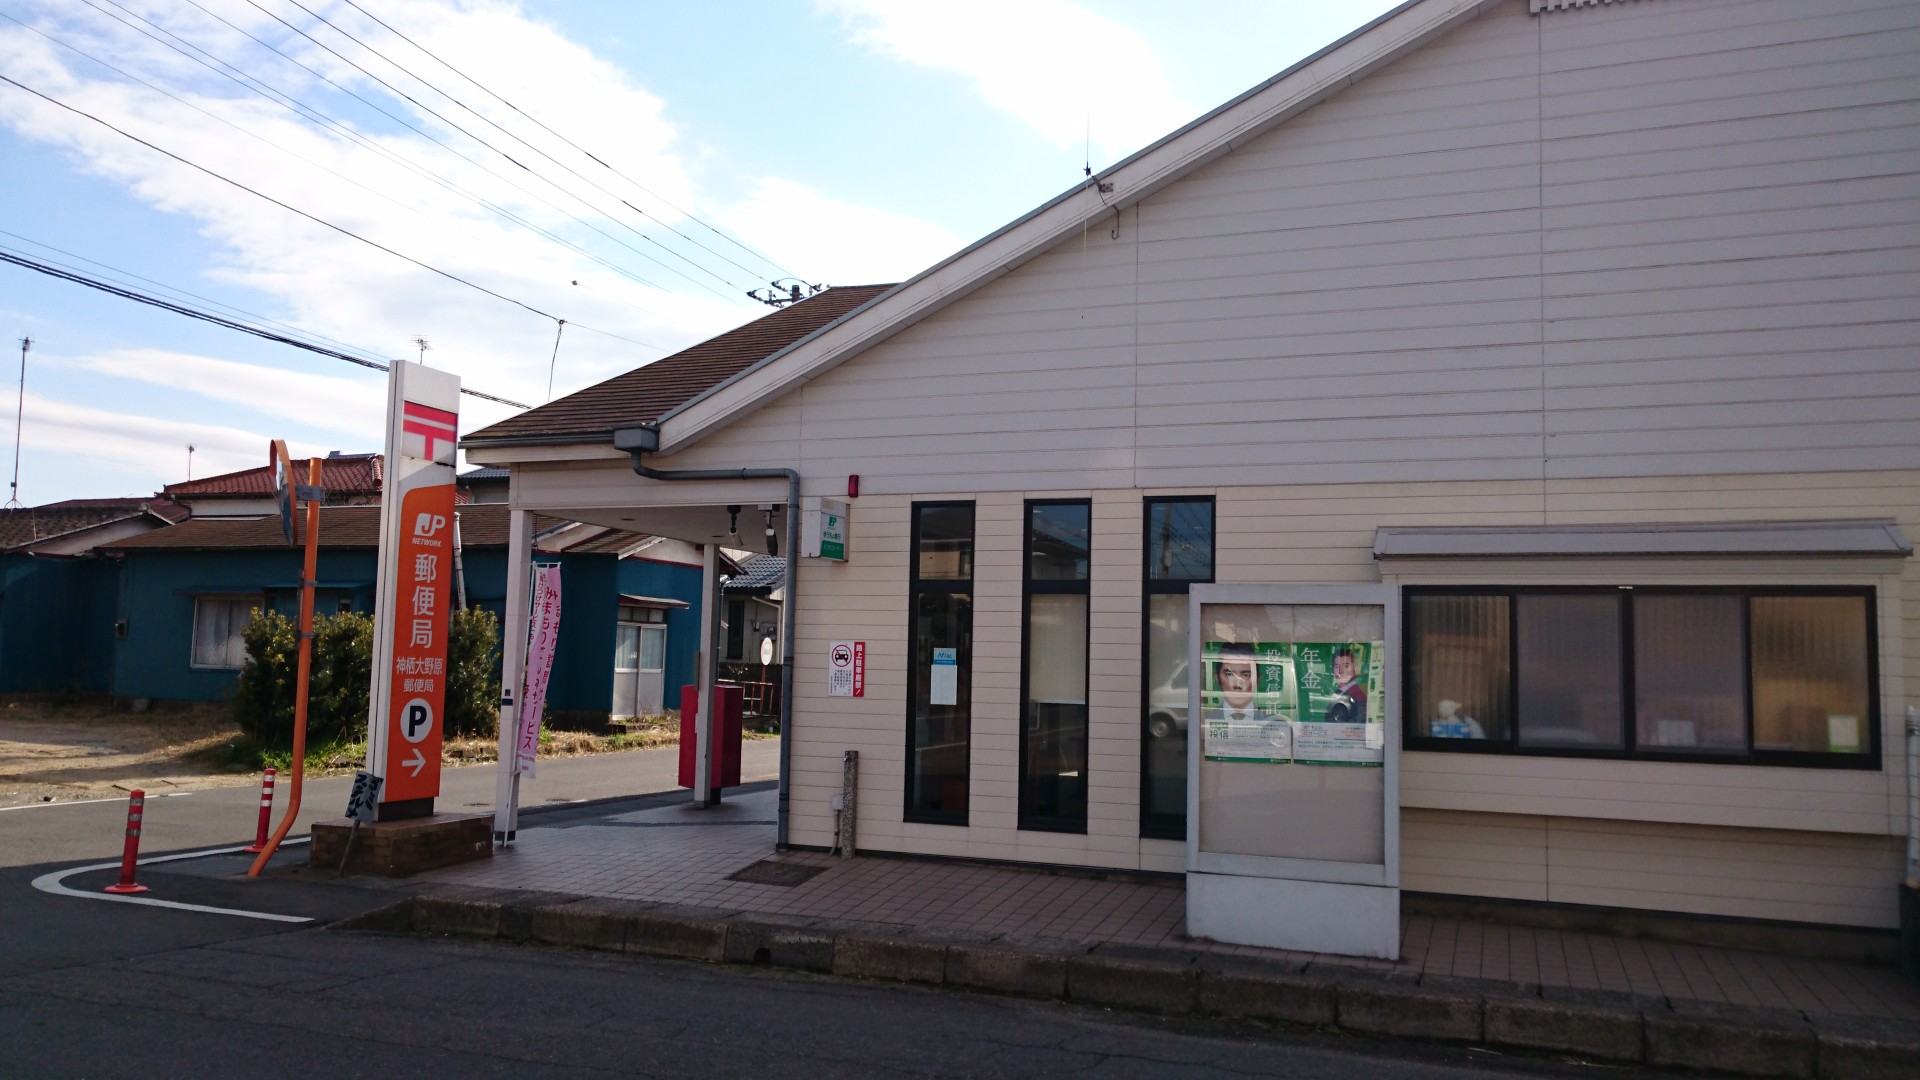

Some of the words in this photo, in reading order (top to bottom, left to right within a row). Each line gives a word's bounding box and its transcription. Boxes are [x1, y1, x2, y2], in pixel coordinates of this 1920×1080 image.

[415, 513, 446, 537] JP
[412, 537, 442, 548] NETWORK
[409, 553, 438, 649] 郵便局
[396, 657, 443, 676] 神栖大野原
[1300, 647, 1322, 689] 年金
[403, 678, 434, 693] 郵便局
[1265, 649, 1281, 716] 投資信託
[408, 705, 427, 737] P
[1209, 729, 1229, 740] 投信
